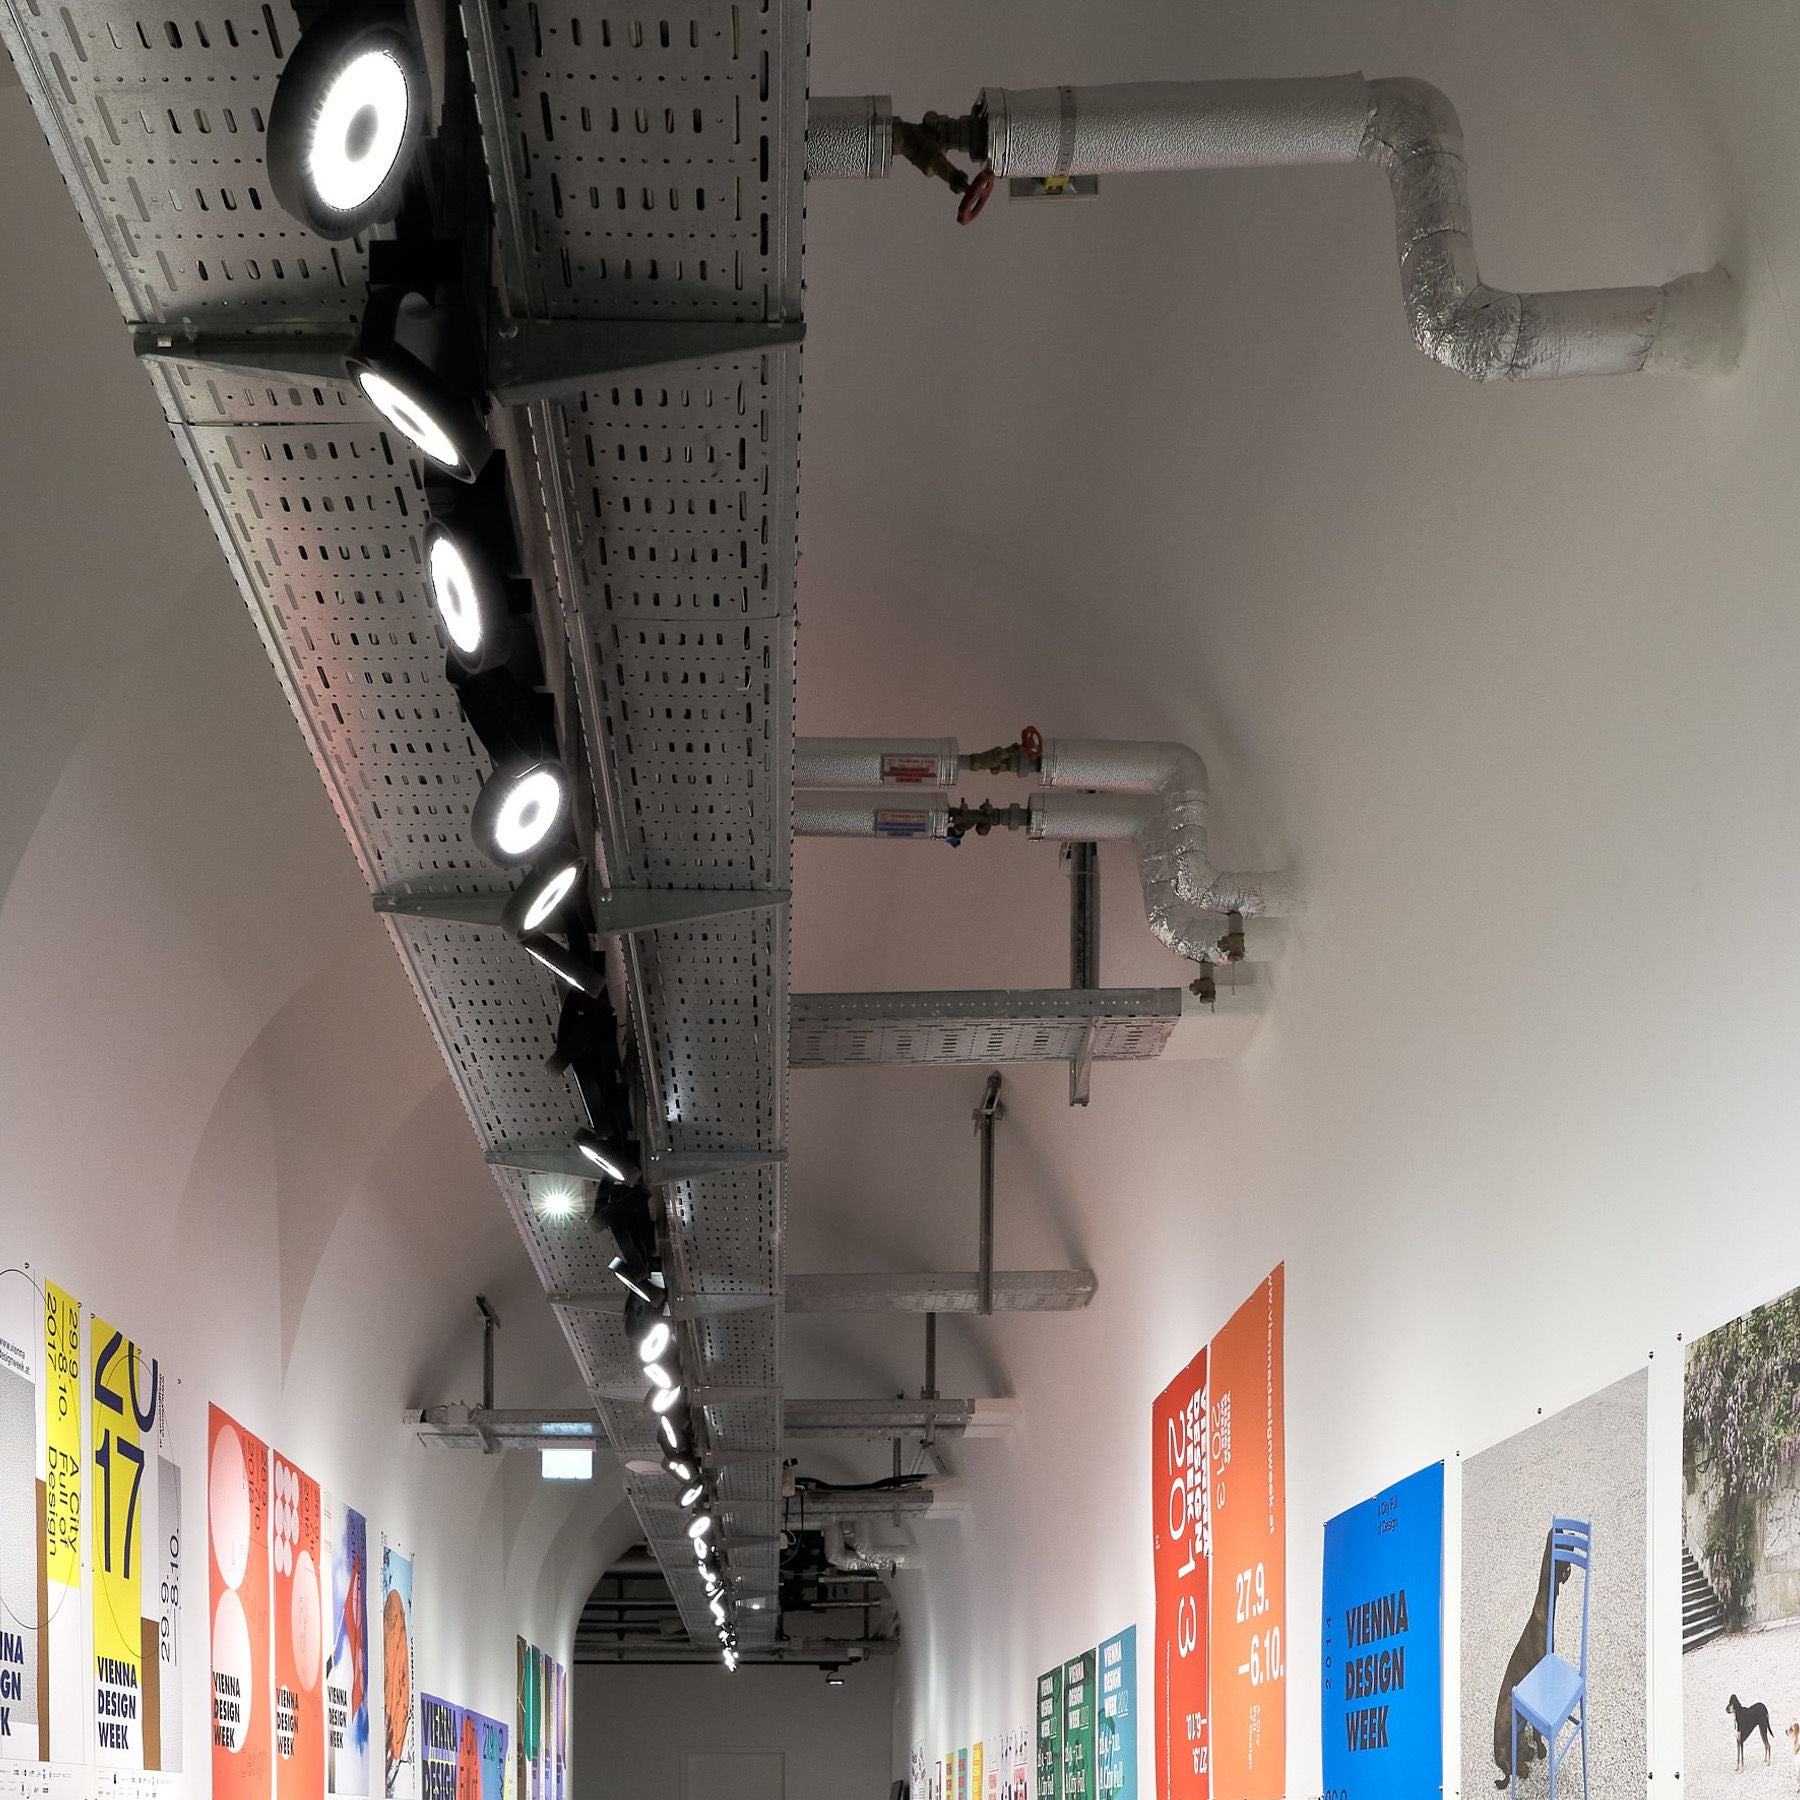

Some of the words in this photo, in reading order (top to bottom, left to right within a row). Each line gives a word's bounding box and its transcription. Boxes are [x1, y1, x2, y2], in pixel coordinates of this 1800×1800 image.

[46, 1291, 57, 1372] 2017
[68, 1307, 79, 1384] 29.9.
[59, 1452, 68, 1505] Full
[69, 1455, 79, 1477] A
[1186, 1394, 1194, 1524] WEEK
[1193, 1387, 1203, 1554] DESIGN
[1211, 1402, 1226, 1510] 2013
[47, 1446, 57, 1556] Design
[69, 1492, 80, 1553] City
[95, 1428, 145, 1580] 17
[59, 1516, 68, 1549] of
[1168, 1410, 1197, 1658] 2013
[161, 1574, 170, 1663] 29.9.
[1235, 1561, 1269, 1624] 27.9.
[1345, 1589, 1409, 1649] VIENNA
[97, 1655, 138, 1689] VIENNA
[212, 1671, 241, 1698] VIENNA
[1345, 1646, 1405, 1702] DESIGN
[97, 1688, 136, 1720] DESIGN
[213, 1698, 241, 1724] DESIGN
[421, 1700, 458, 1752] VIENNA
[1345, 1705, 1389, 1752] WEEK
[98, 1721, 129, 1750] WEEK
[213, 1725, 235, 1748] WEEK
